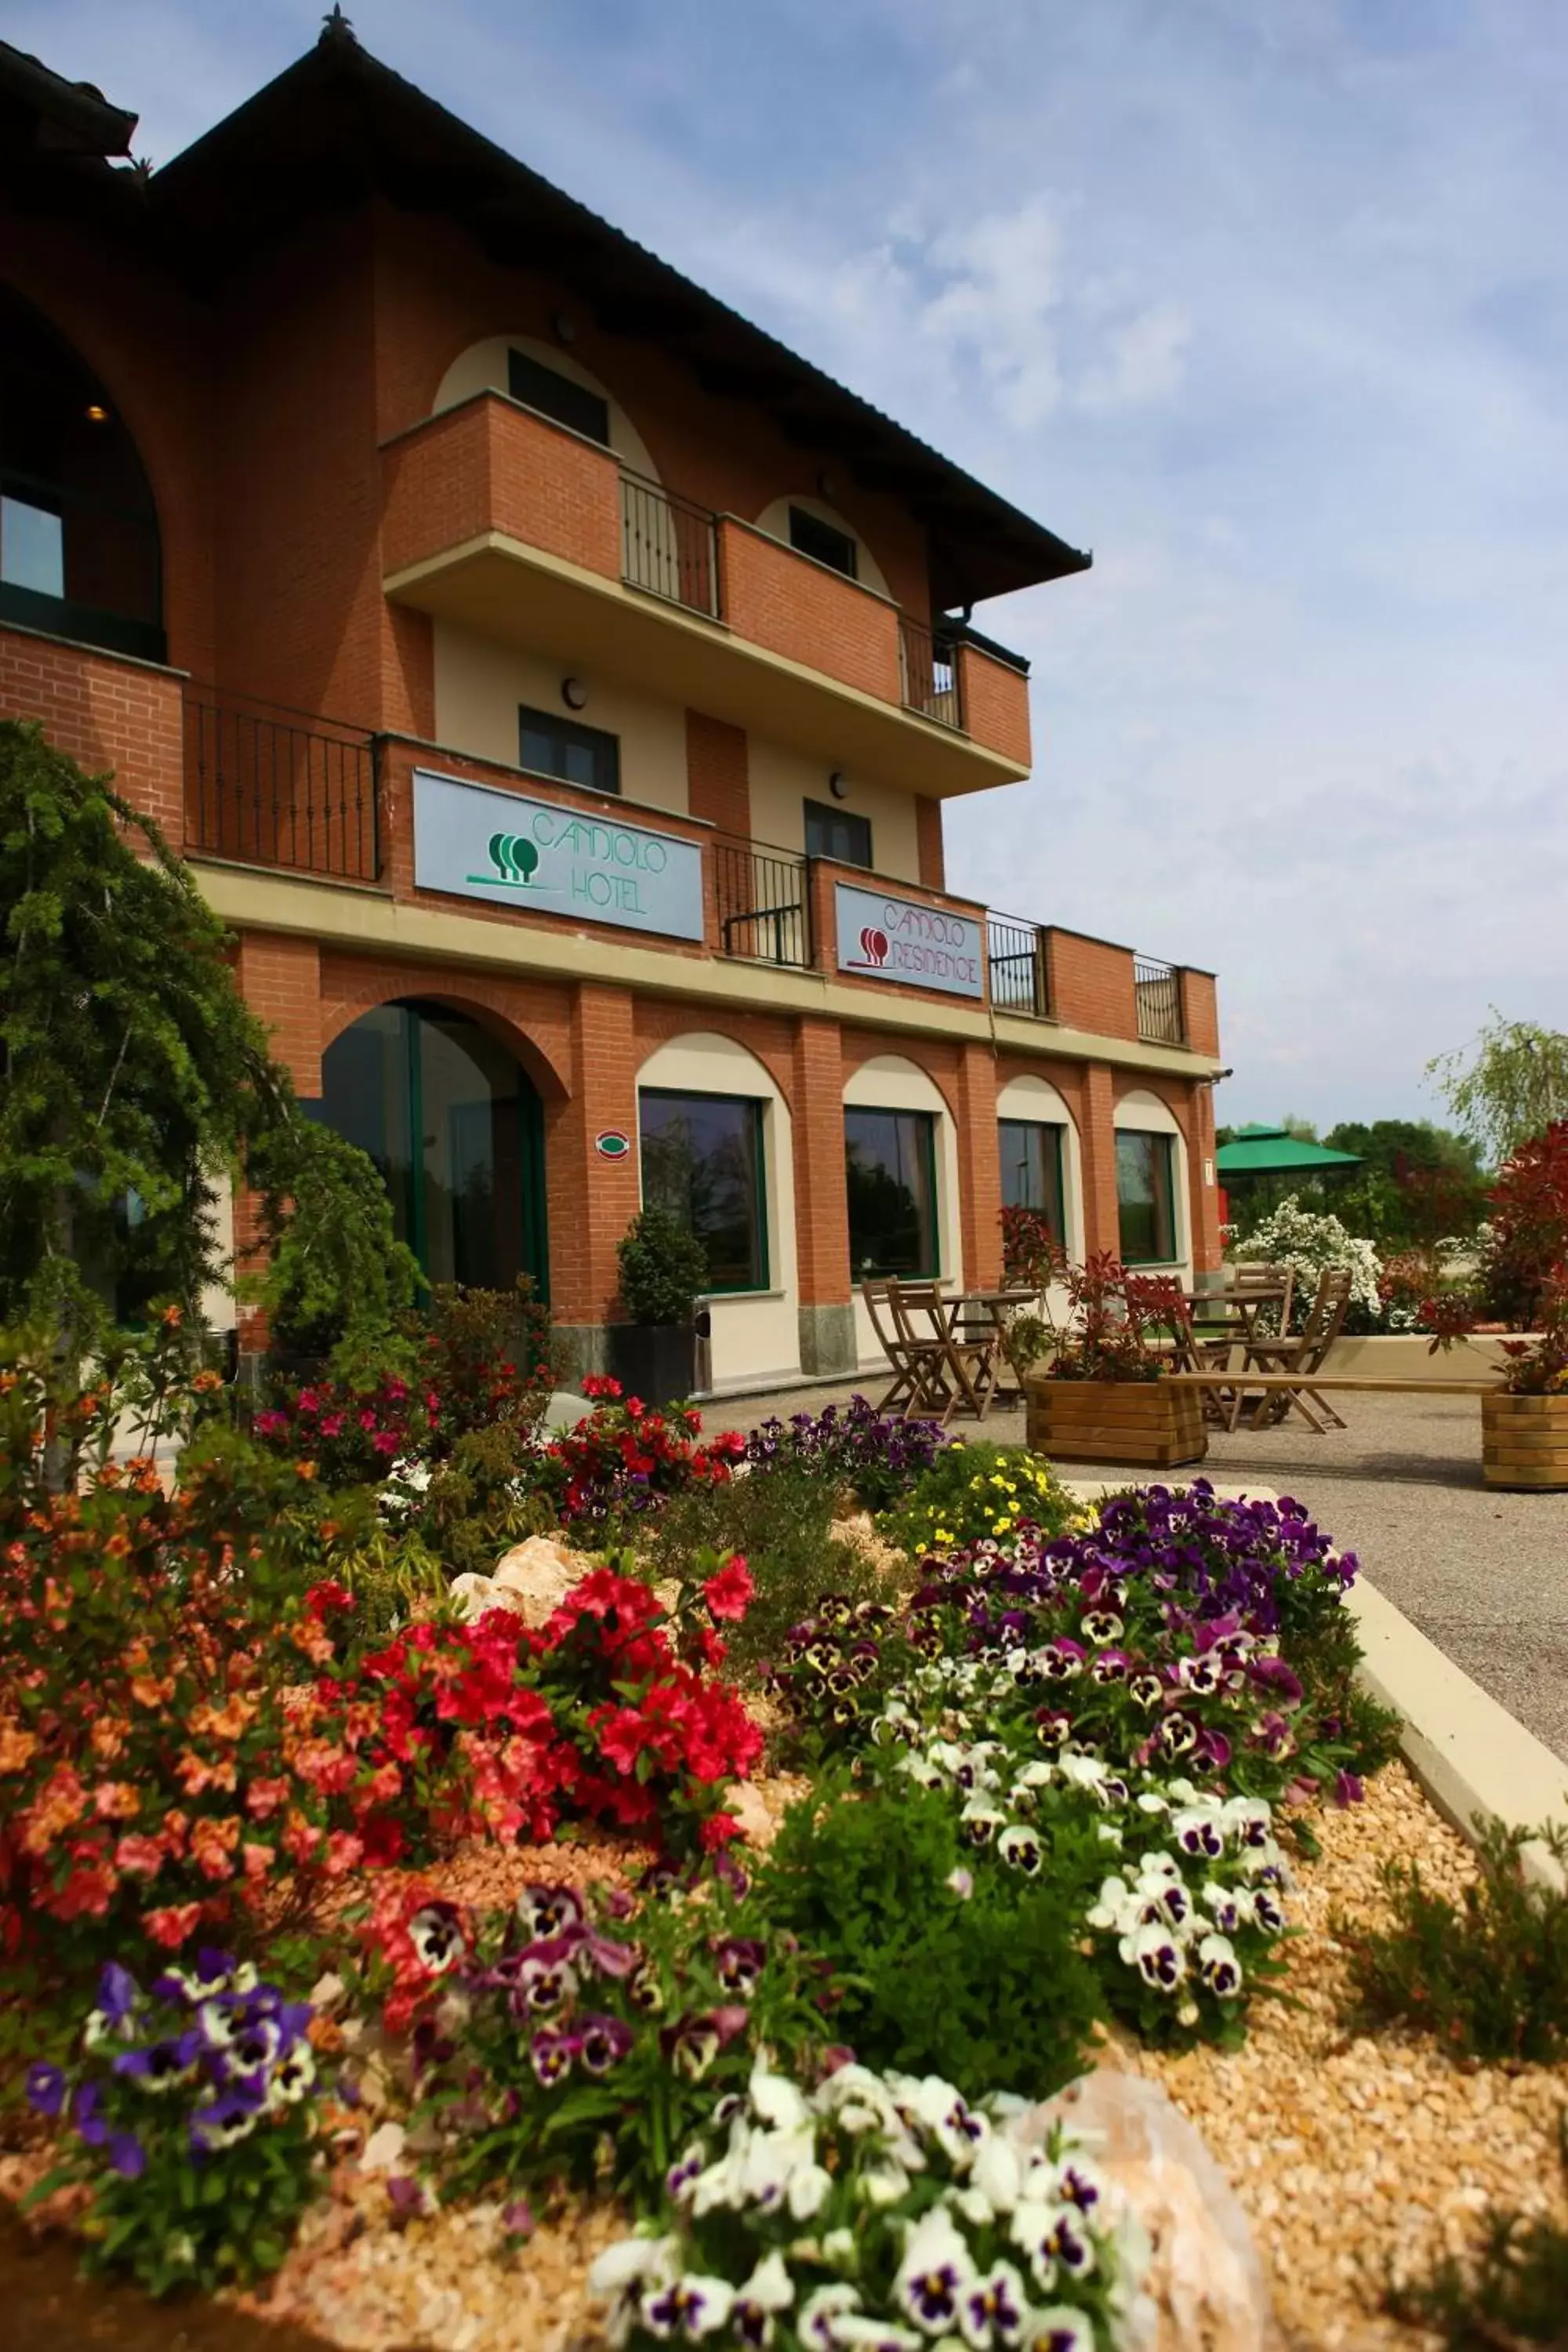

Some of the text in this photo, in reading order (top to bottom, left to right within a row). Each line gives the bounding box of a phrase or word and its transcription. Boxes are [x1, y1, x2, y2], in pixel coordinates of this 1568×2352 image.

[532, 812, 667, 873] CANDIOLO
[572, 866, 647, 915] HOTEL
[891, 940, 979, 984] RESIDENCE
